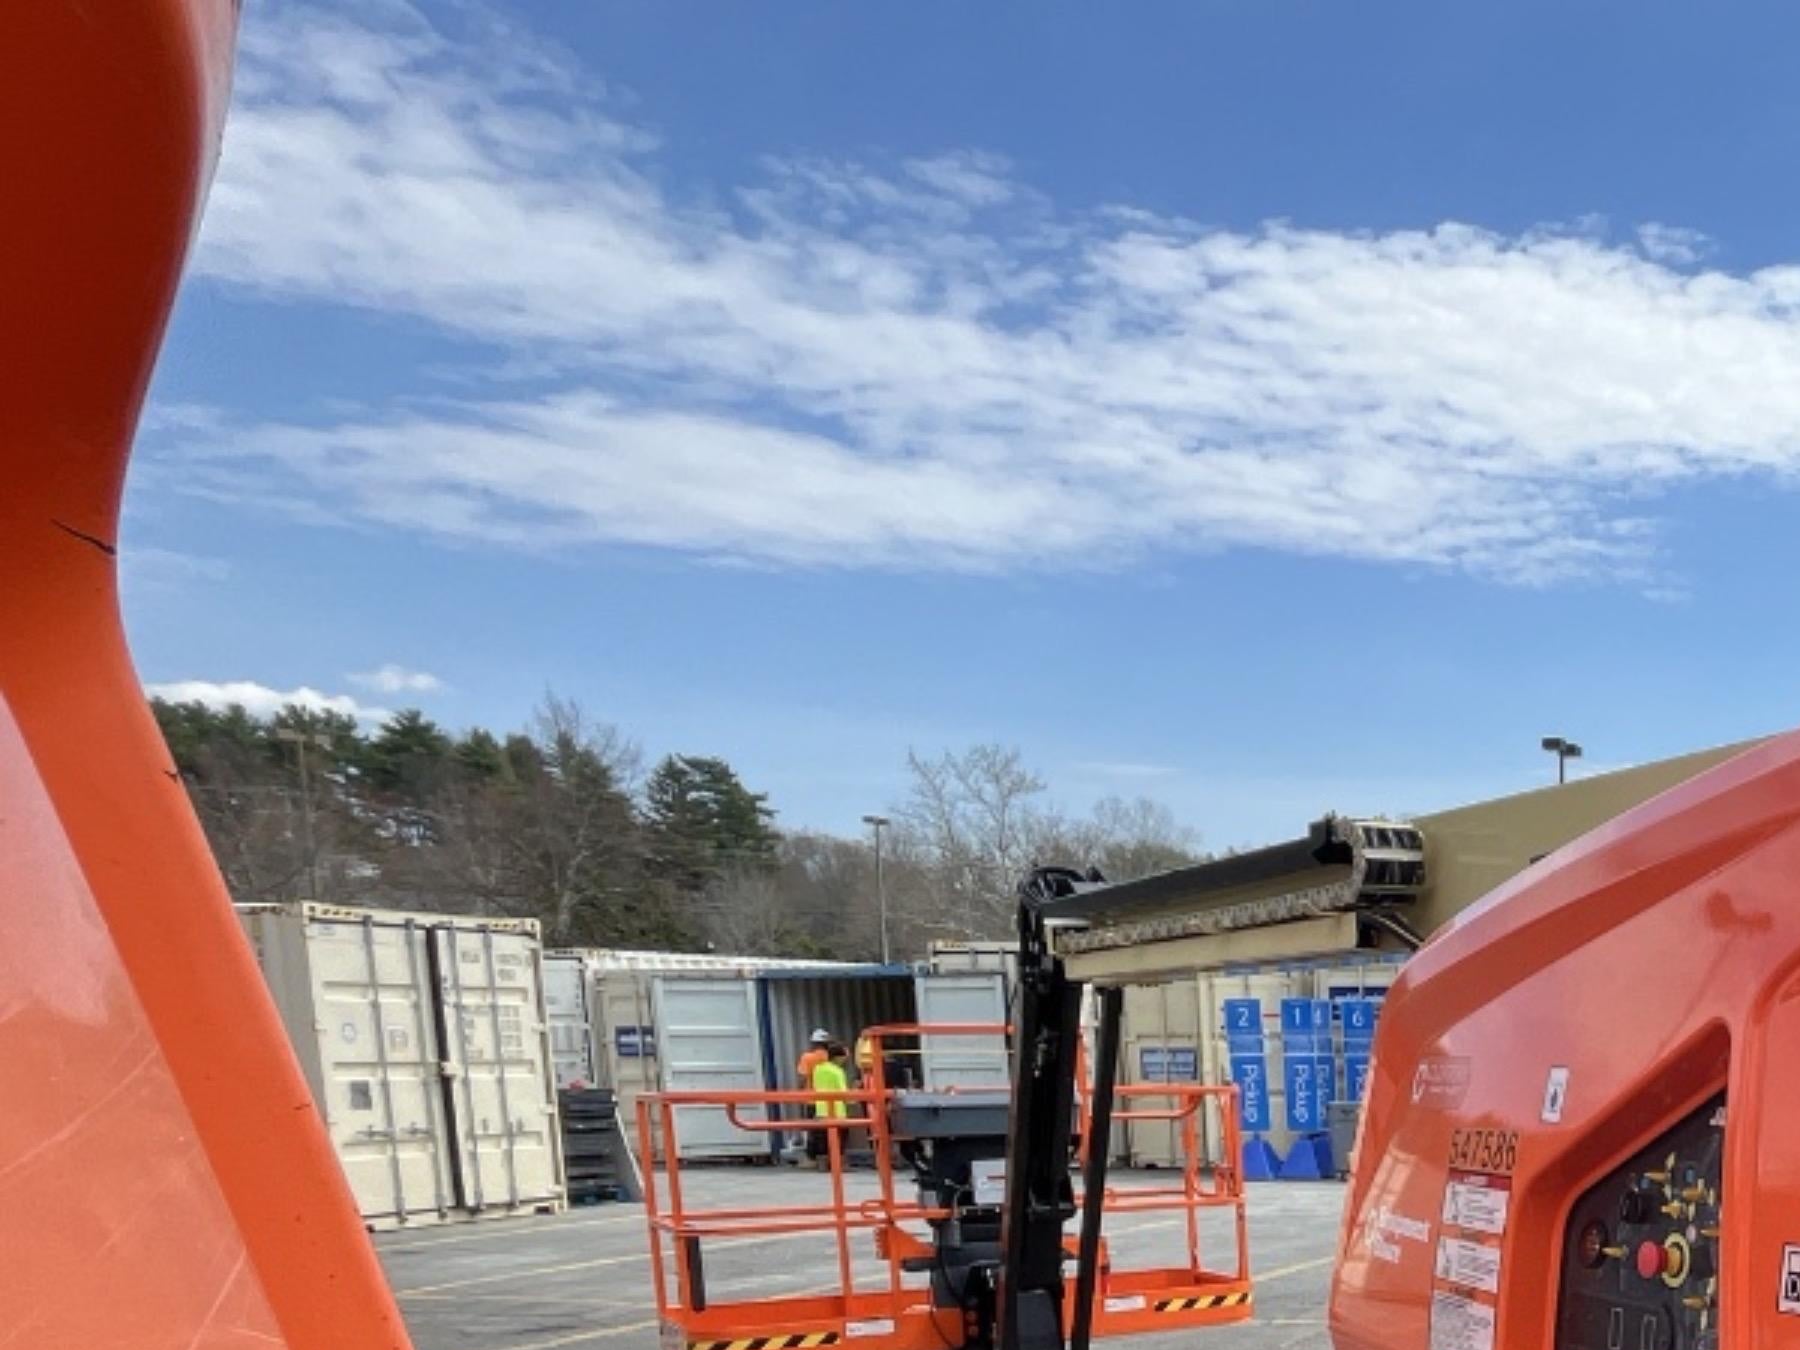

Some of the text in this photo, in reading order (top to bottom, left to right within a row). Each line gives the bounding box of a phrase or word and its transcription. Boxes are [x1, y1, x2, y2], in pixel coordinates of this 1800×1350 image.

[1237, 1007, 1250, 1027] 2
[1294, 1007, 1300, 1026] 1
[1351, 1009, 1363, 1028] 6
[1241, 1064, 1258, 1123] Pickup
[1293, 1064, 1309, 1123] Pickup
[1449, 1130, 1519, 1171] 547586
